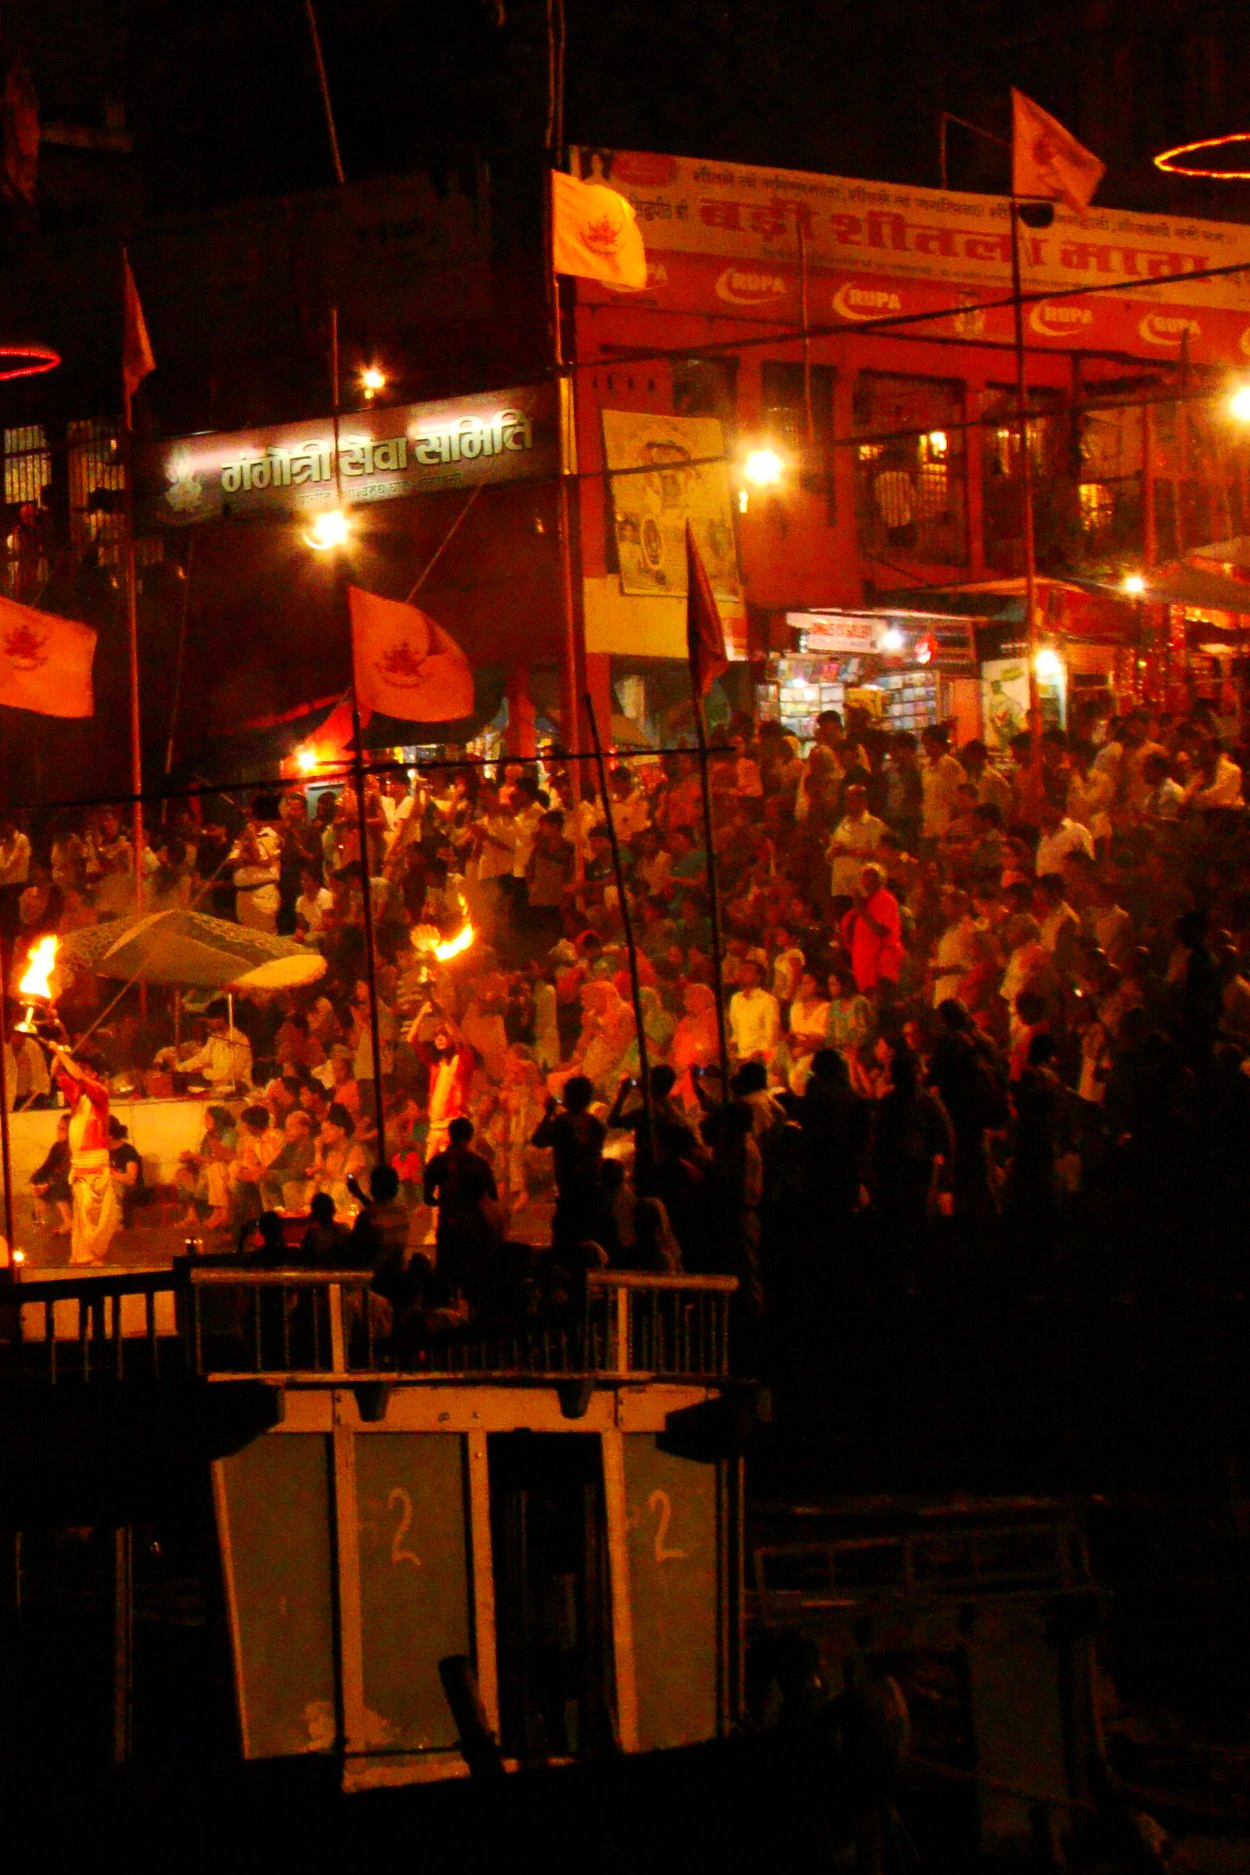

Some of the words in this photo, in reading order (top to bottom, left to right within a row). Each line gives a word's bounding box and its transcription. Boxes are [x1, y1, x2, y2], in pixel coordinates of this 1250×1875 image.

[830, 209, 1049, 266] शीतला
[1059, 240, 1209, 283] माता
[731, 272, 786, 293] RUPA
[849, 288, 902, 310] RUPA
[1044, 305, 1092, 324] RUPA
[221, 439, 332, 493] गंगोत्री
[339, 432, 408, 477] सेवा
[414, 407, 534, 465] समिति
[387, 1486, 422, 1567] 2
[649, 1490, 687, 1562] 2
